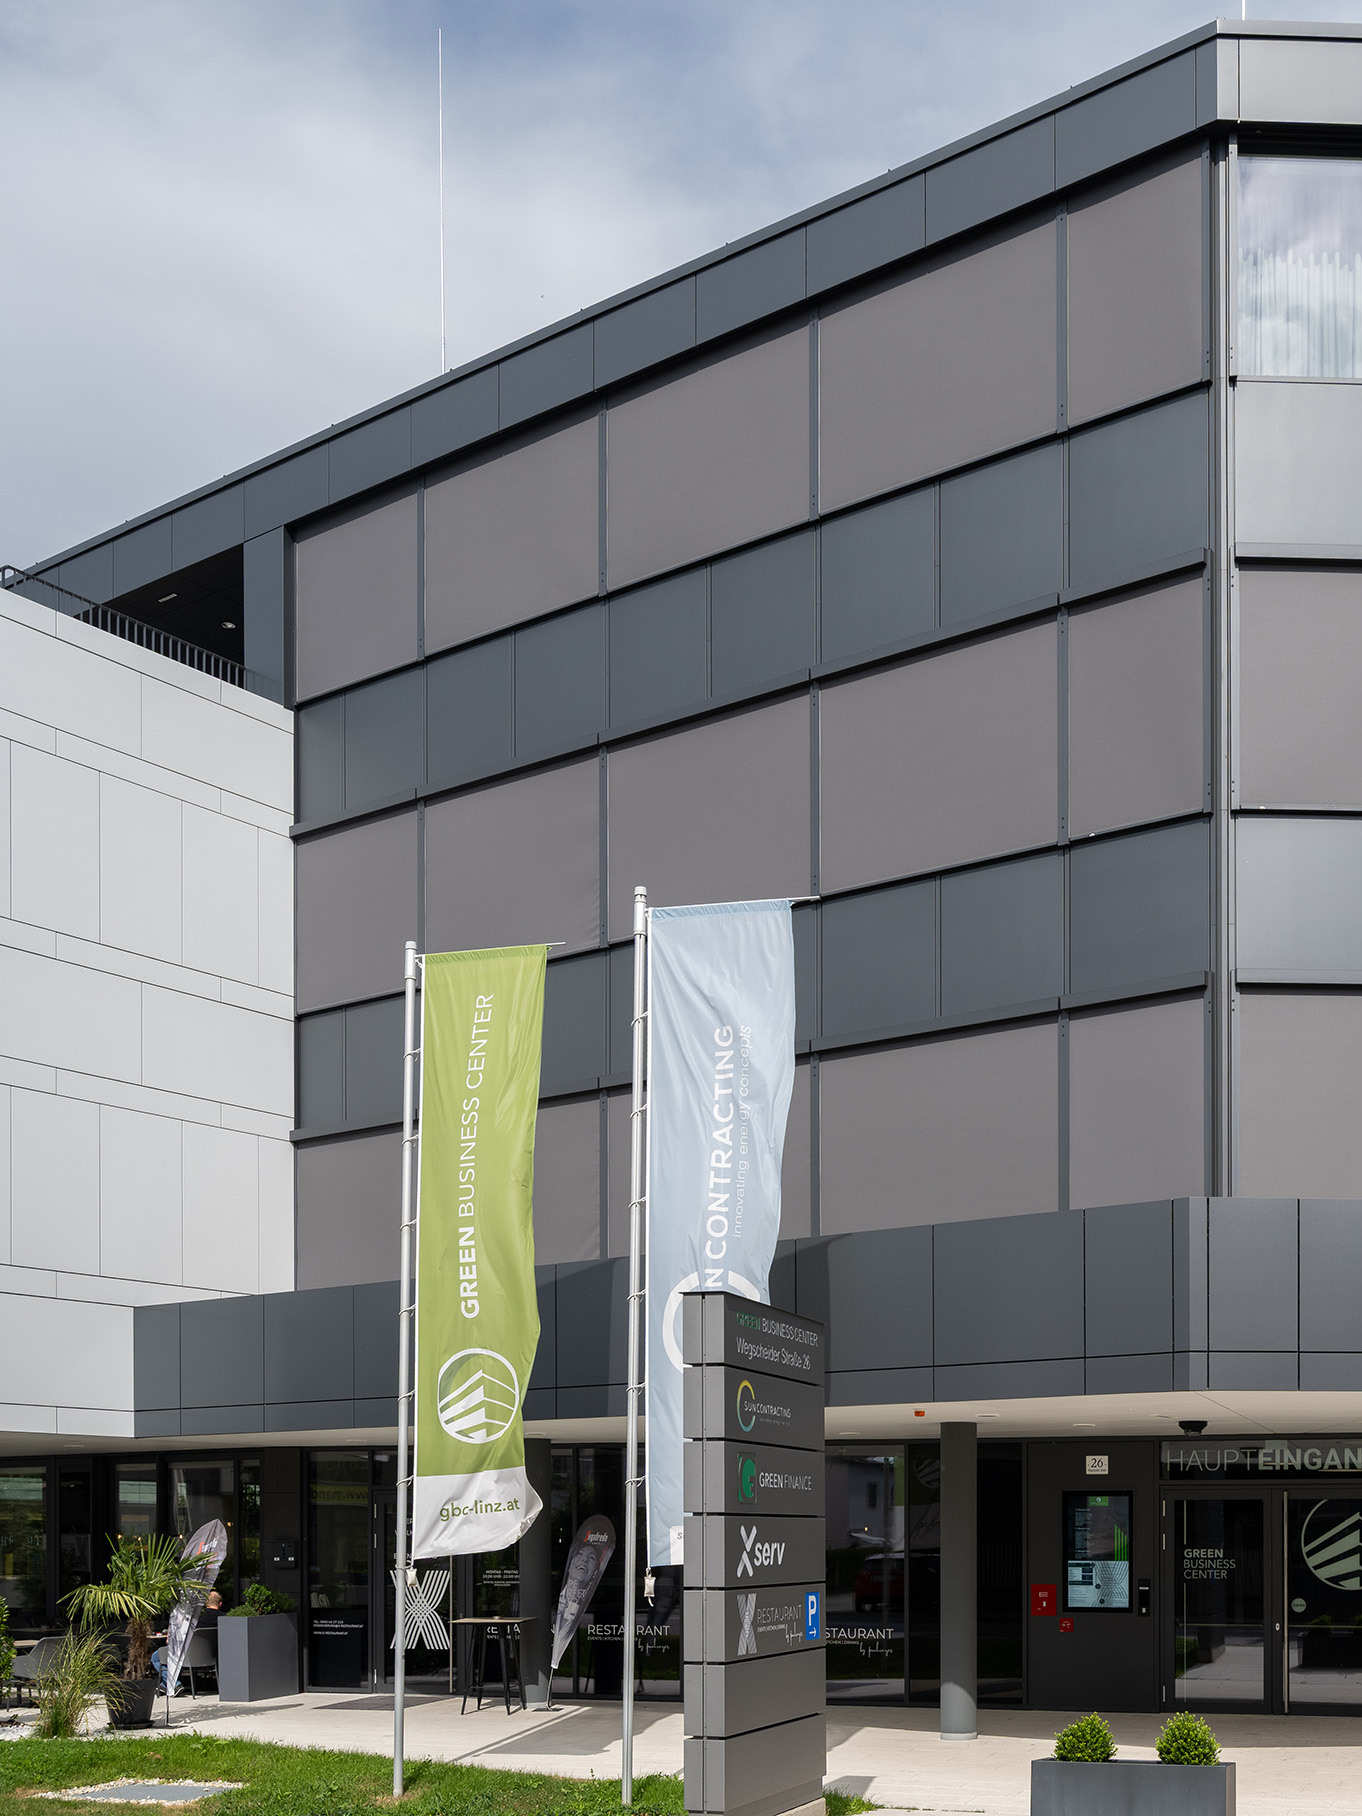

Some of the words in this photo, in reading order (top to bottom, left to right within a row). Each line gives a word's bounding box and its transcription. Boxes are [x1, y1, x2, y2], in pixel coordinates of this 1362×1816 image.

[465, 993, 495, 1091] CENTER
[739, 1024, 753, 1096] concepts
[704, 1025, 735, 1260] CONTRACTING
[738, 1100, 751, 1154] energy
[458, 1097, 481, 1218] BUSINESS
[732, 1160, 750, 1238] innovating
[458, 1226, 480, 1319] GREEN
[736, 1310, 761, 1331] GREEN
[762, 1317, 794, 1340] BUSINESS
[794, 1327, 819, 1348] CENTER
[736, 1336, 780, 1362] Wegscheider
[803, 1353, 811, 1370] 26
[1090, 1457, 1104, 1468] 26
[440, 1498, 520, 1521] gbc-linz.at
[1183, 1548, 1224, 1559] GREEN
[1183, 1559, 1236, 1569] BUSINESS
[1183, 1569, 1228, 1580] CENTER
[757, 1604, 802, 1624] RESTAURANT
[808, 1595, 817, 1627] P
[587, 1624, 671, 1636] RESTARANT
[825, 1627, 895, 1640] STAURANT
